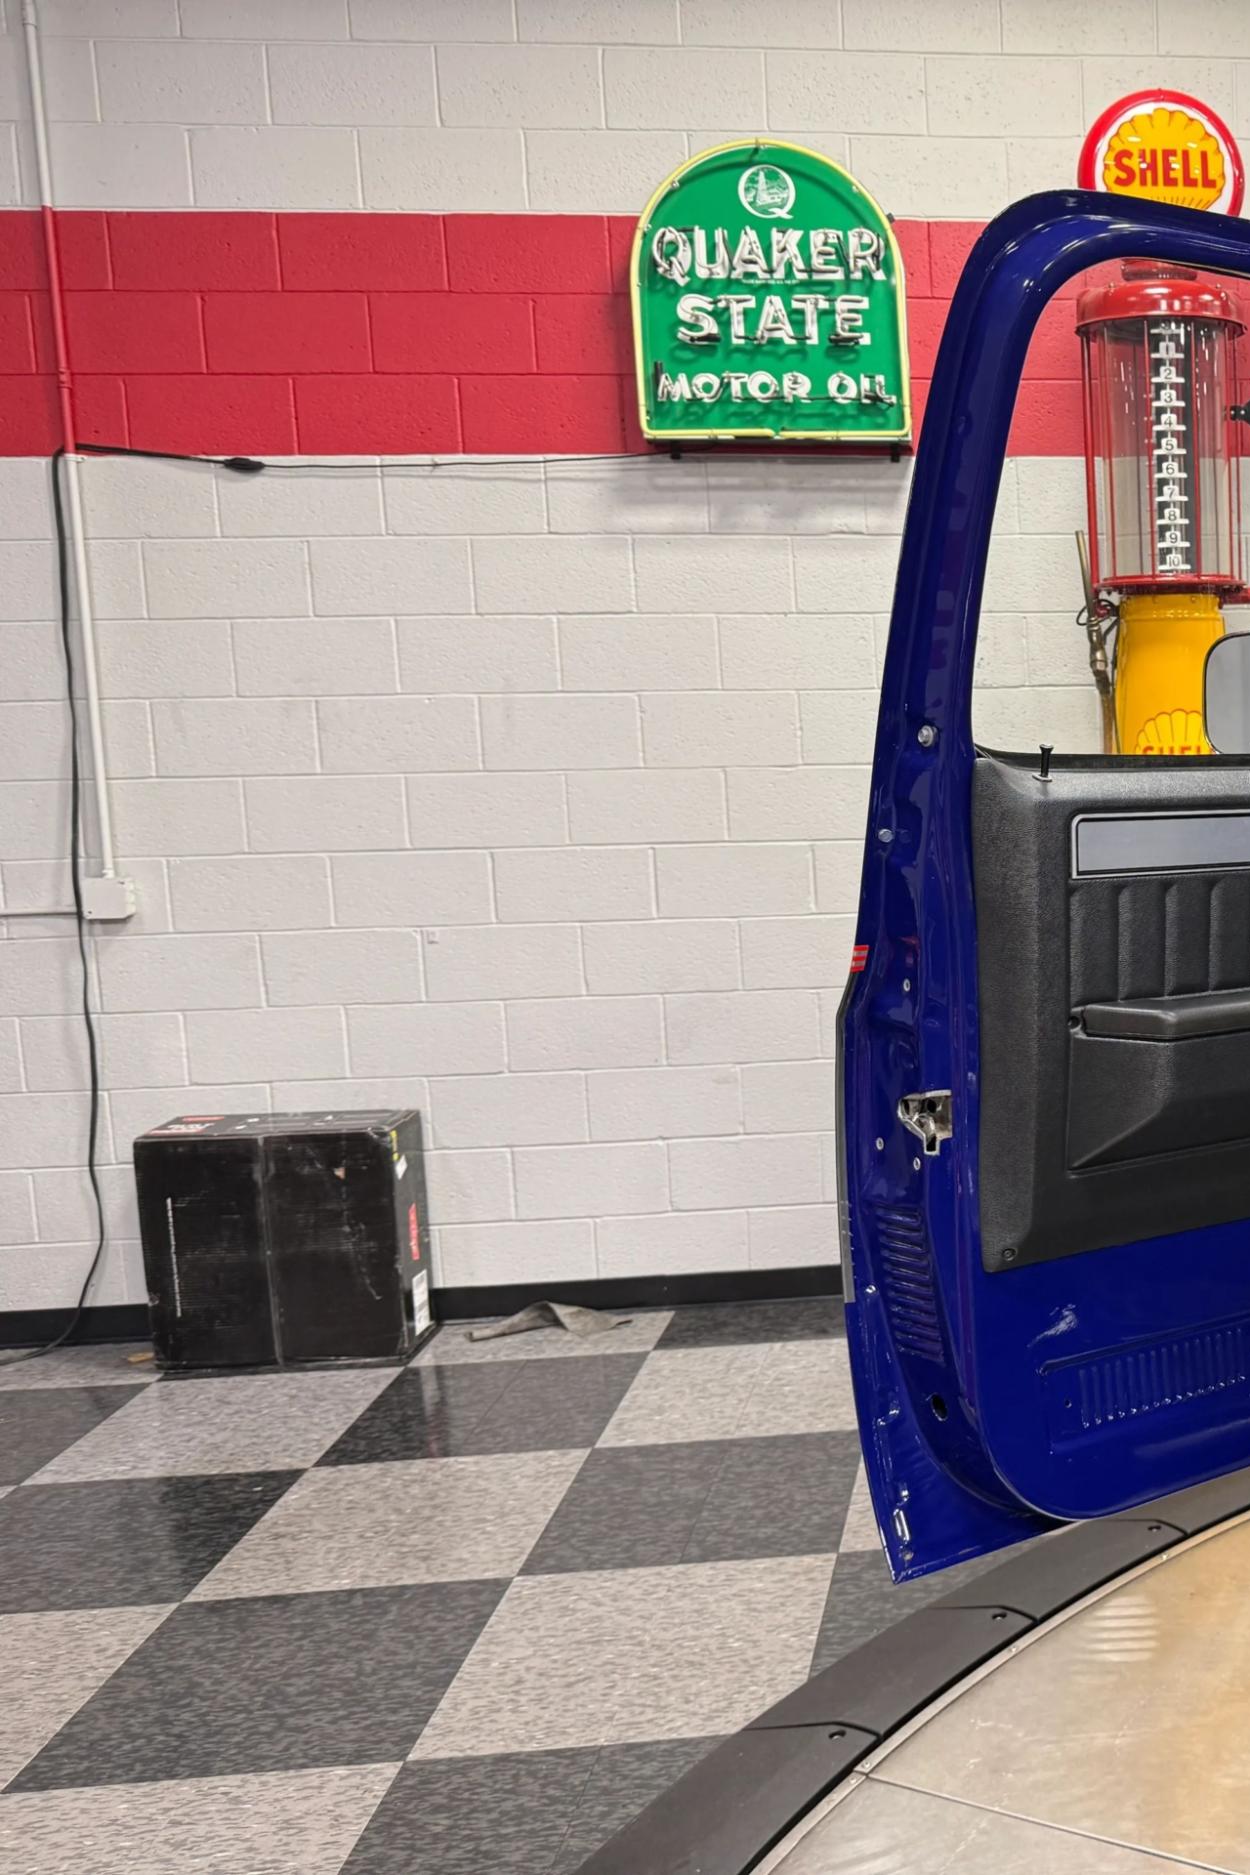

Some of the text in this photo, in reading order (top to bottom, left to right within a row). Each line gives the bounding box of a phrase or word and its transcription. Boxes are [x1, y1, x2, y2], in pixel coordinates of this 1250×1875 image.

[1113, 148, 1217, 188] SHELL
[652, 225, 886, 285] QUAKER
[676, 293, 871, 345] STATE
[1163, 367, 1172, 380] 2
[657, 371, 896, 406] MOTOR OIL
[1164, 391, 1173, 404] 3
[1164, 415, 1173, 428] 4
[1165, 439, 1174, 452] 5
[1165, 463, 1175, 476] 6
[1167, 487, 1175, 499] 7
[1168, 510, 1177, 521] 8
[1169, 532, 1178, 544] 9
[1168, 556, 1180, 567] 10
